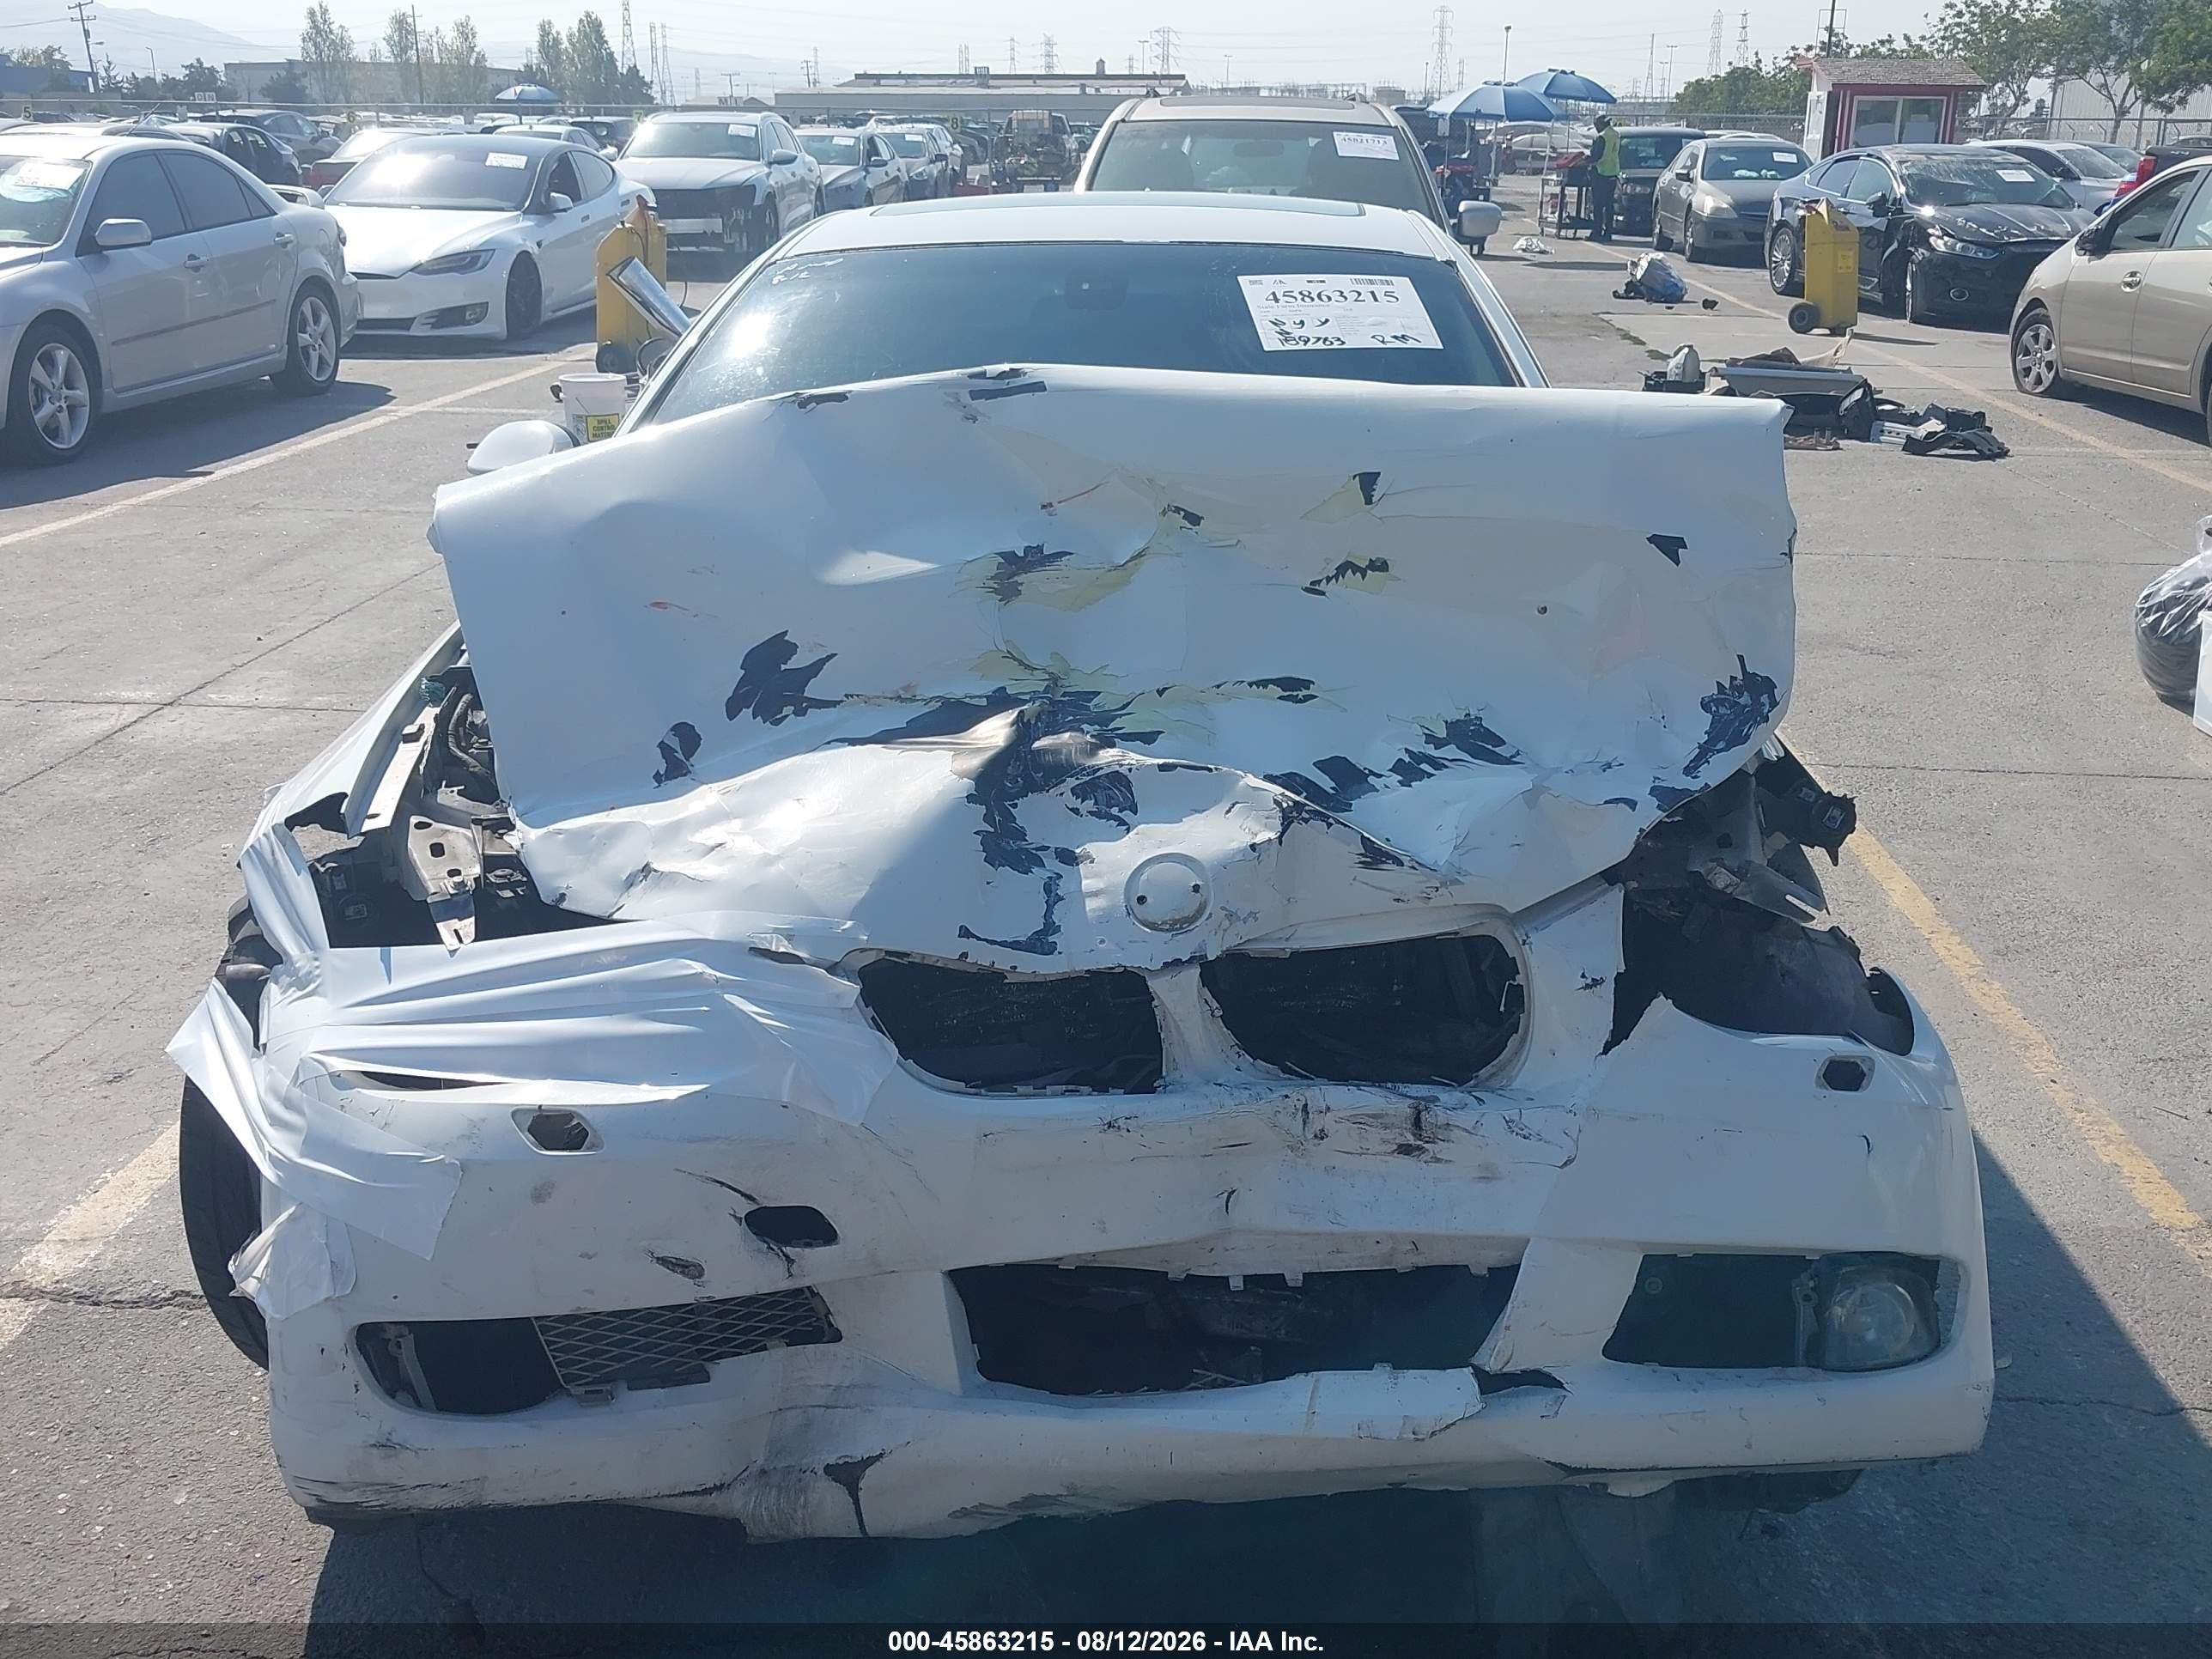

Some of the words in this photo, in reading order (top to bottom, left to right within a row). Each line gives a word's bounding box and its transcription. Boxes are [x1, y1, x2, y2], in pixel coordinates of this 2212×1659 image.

[24, 106, 31, 118] 5
[347, 112, 355, 123] 6
[635, 112, 642, 122] 7
[951, 117, 959, 129] 8
[1265, 289, 1400, 304] 45863215
